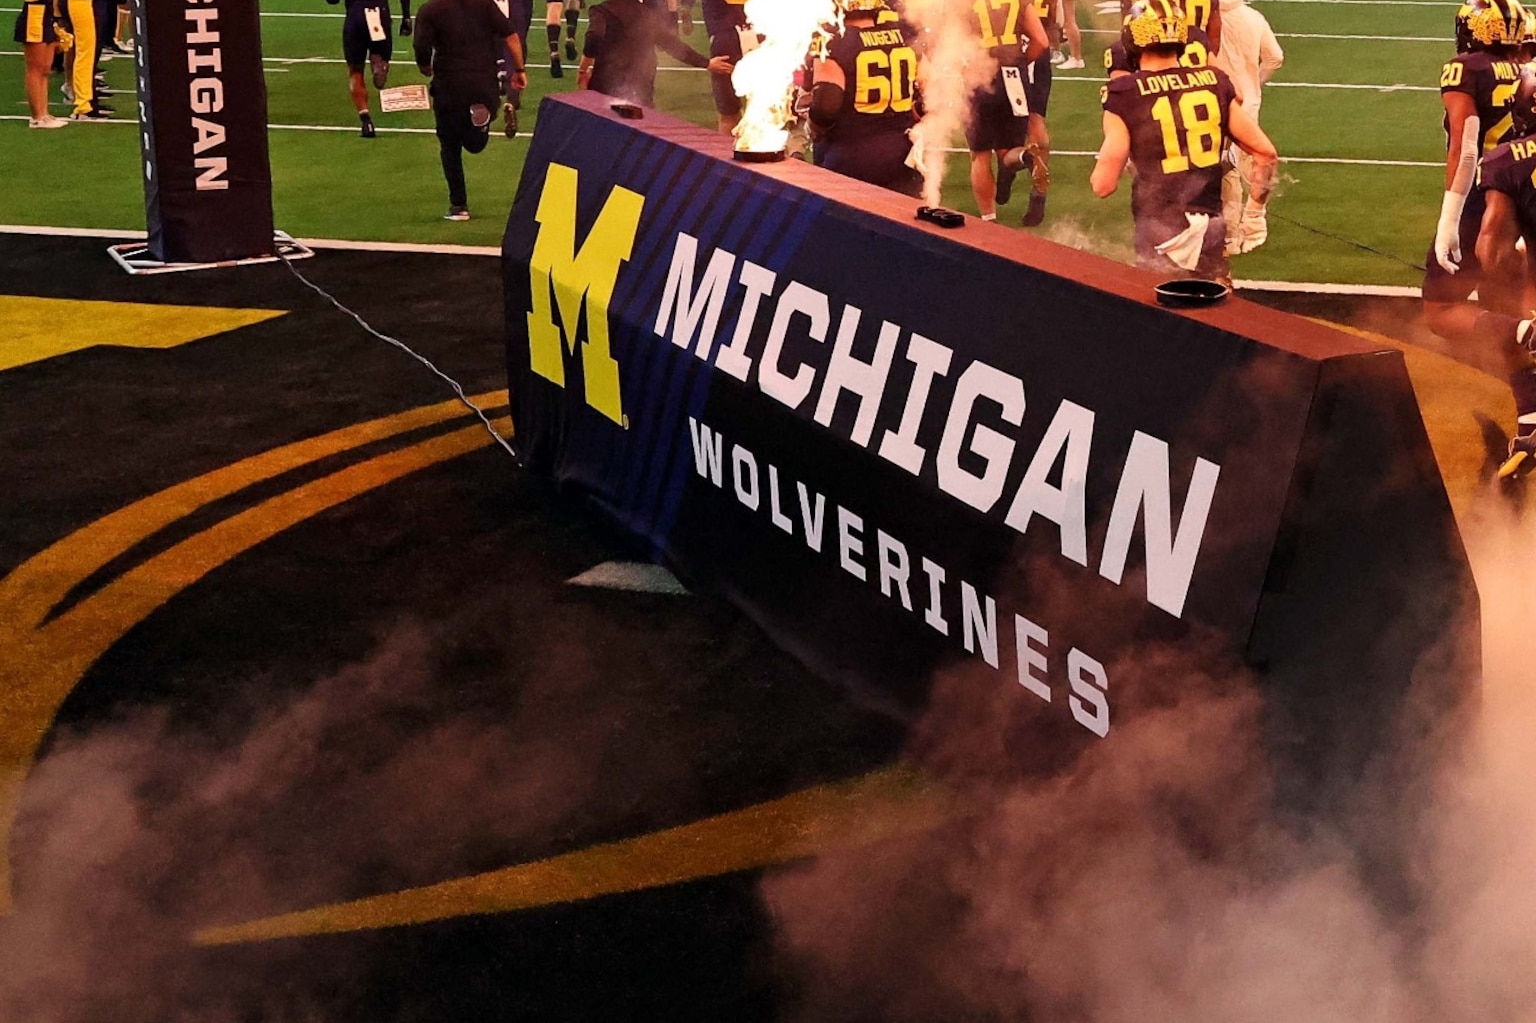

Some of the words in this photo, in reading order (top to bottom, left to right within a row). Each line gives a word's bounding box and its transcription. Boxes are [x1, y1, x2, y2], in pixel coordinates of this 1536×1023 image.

[859, 29, 905, 48] NUGENT
[854, 46, 919, 115] 60
[1135, 68, 1218, 96] LOVELAND
[1440, 63, 1463, 87] 20
[1151, 89, 1222, 175] 18
[653, 230, 1221, 619] MICHIGAN
[689, 415, 1110, 739] WOLVERINES
